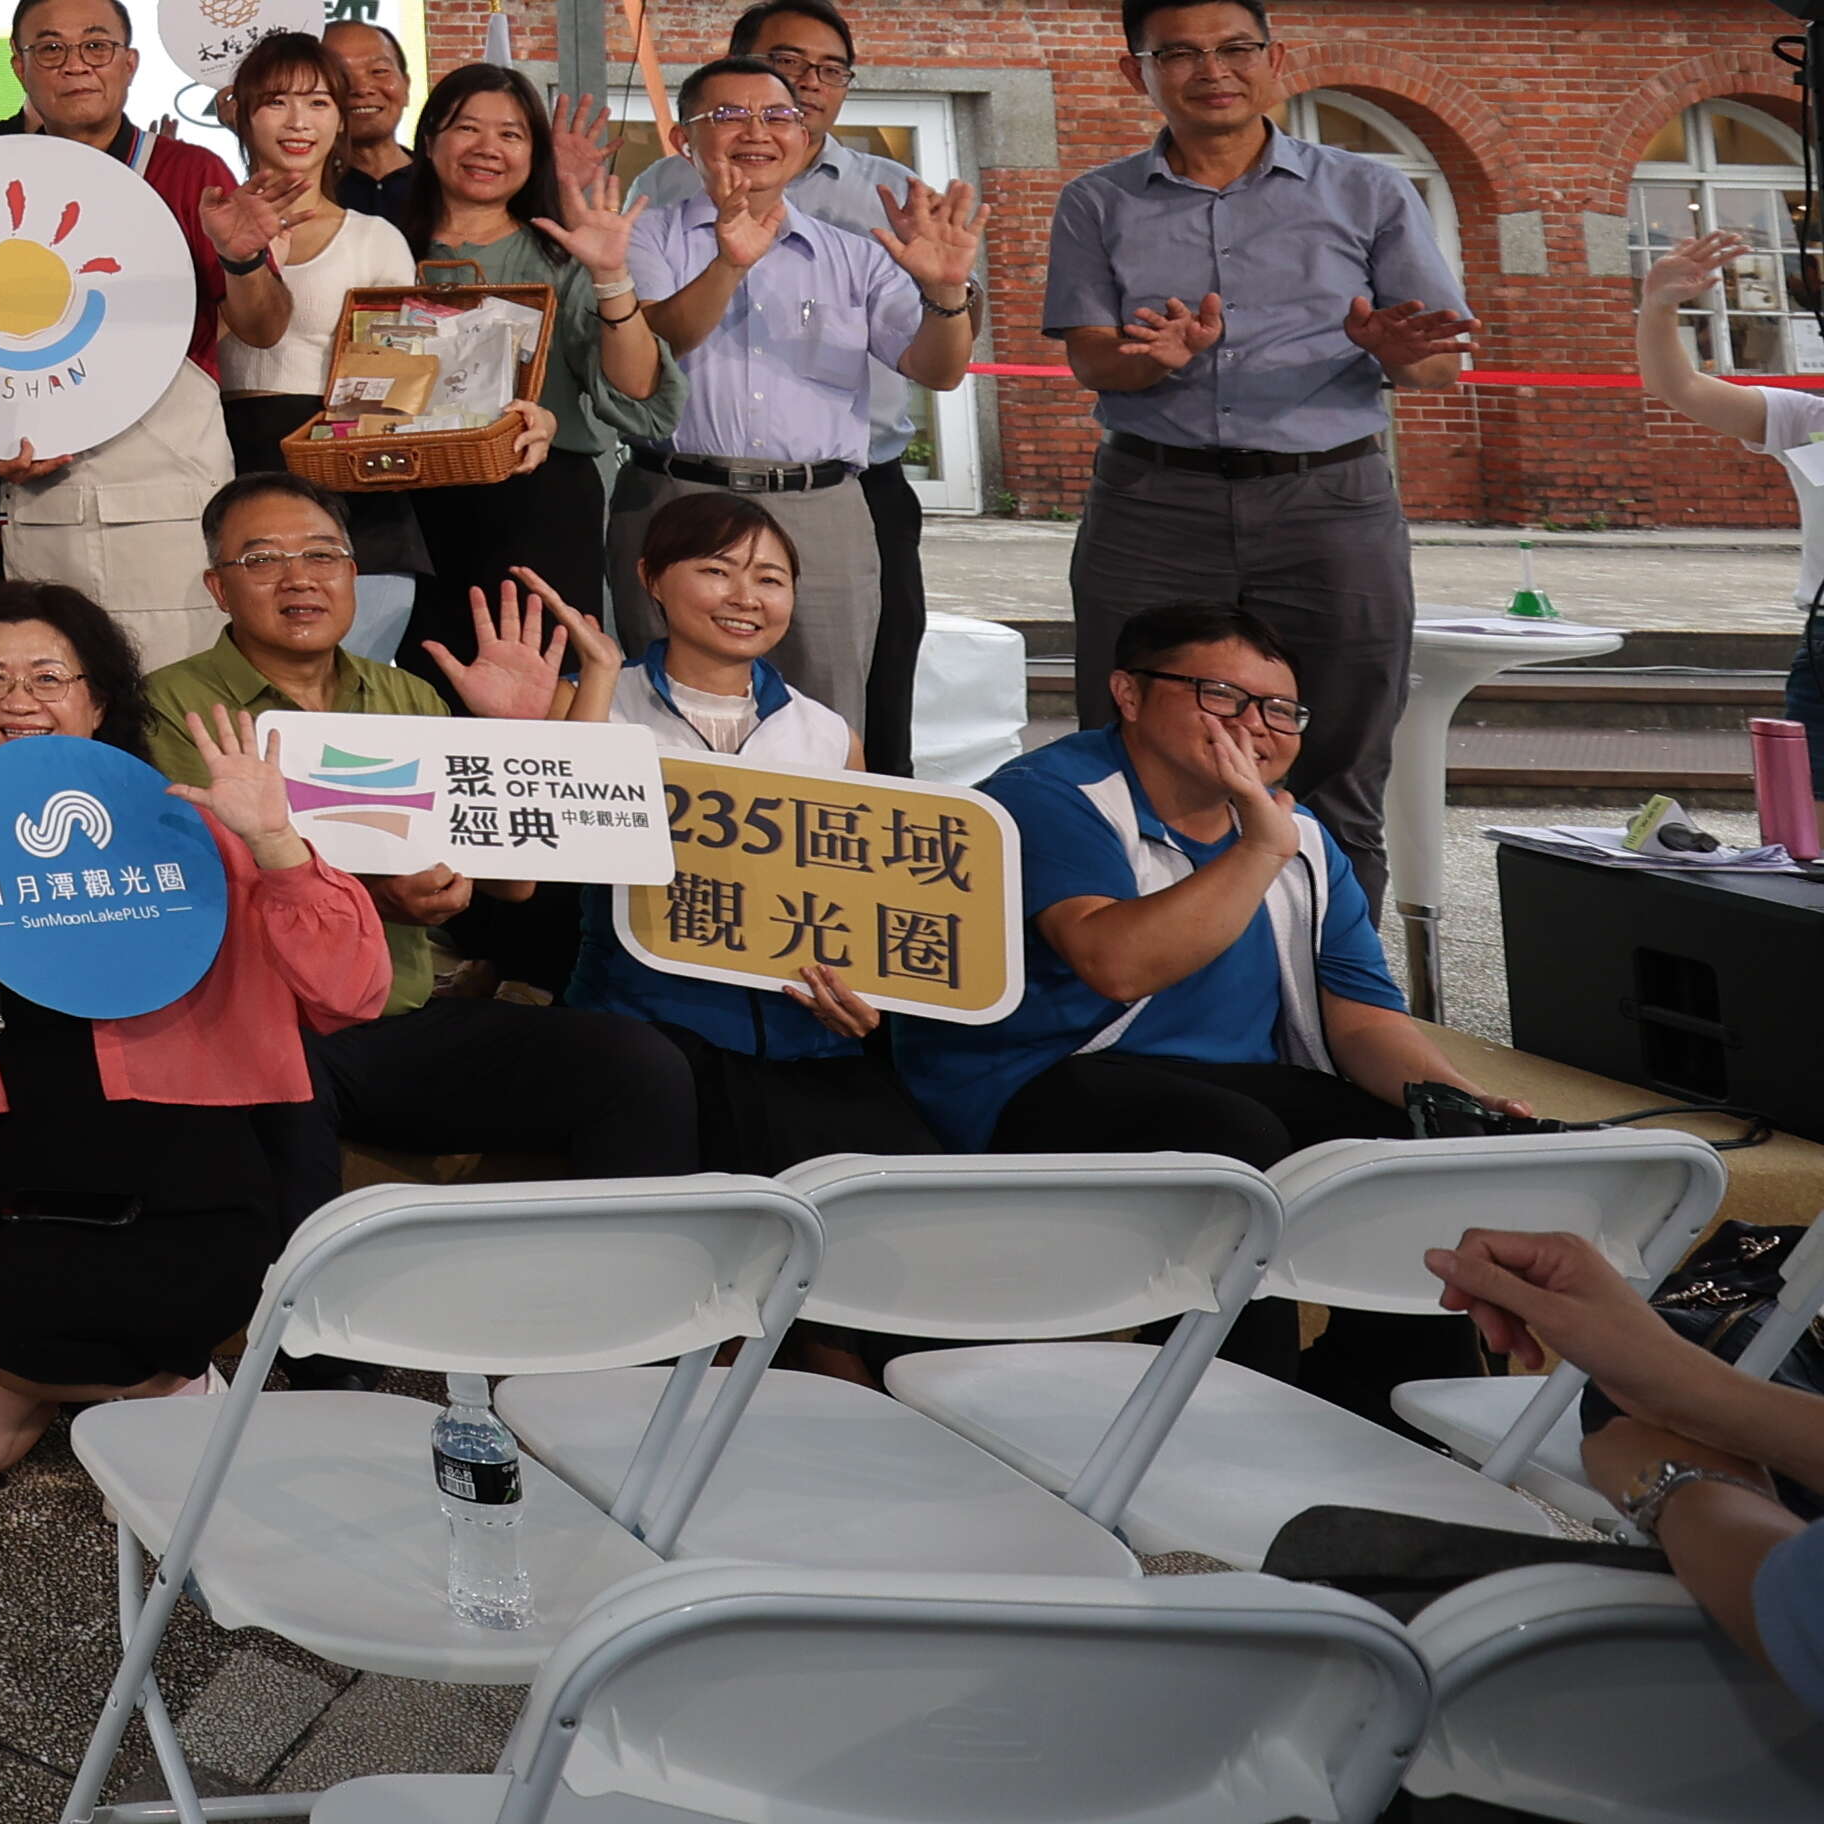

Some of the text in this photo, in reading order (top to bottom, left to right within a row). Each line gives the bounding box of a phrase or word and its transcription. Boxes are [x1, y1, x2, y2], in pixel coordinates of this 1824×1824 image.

[445, 754, 497, 797] 聚
[503, 758, 574, 778] CORE
[506, 780, 647, 802] OF TAIWAN
[449, 804, 560, 850] 經典
[561, 808, 650, 828] 中彰觀光圈
[663, 784, 972, 893] 235區域
[20, 905, 161, 929] SunMoonLakePLUS
[663, 870, 962, 990] 觀光圈
